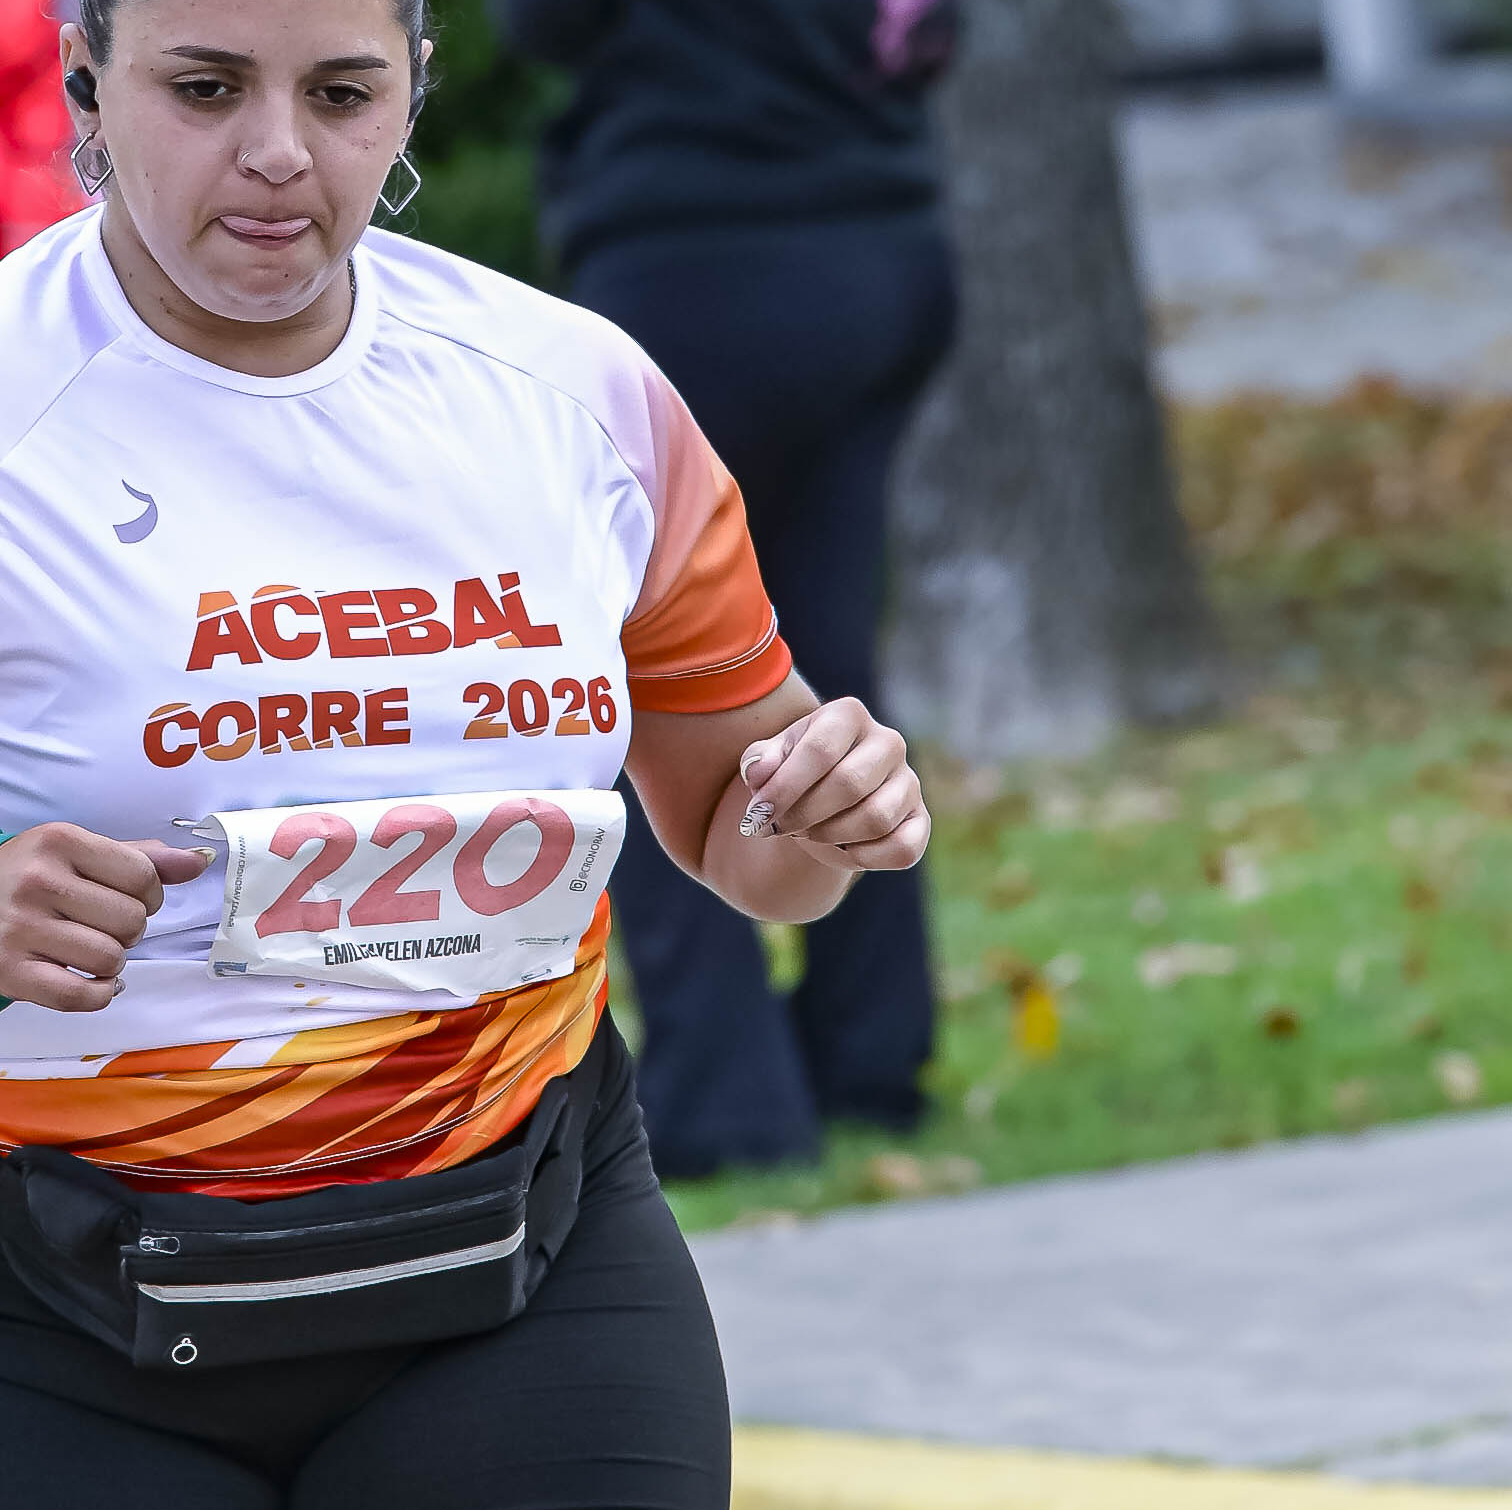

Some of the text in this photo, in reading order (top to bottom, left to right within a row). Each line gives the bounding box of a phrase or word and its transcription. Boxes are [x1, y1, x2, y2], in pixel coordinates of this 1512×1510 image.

[185, 572, 563, 672] ACEBAL
[143, 676, 617, 769] CORRE 2026
[254, 797, 576, 939] 220
[424, 933, 481, 959] AZCONA
